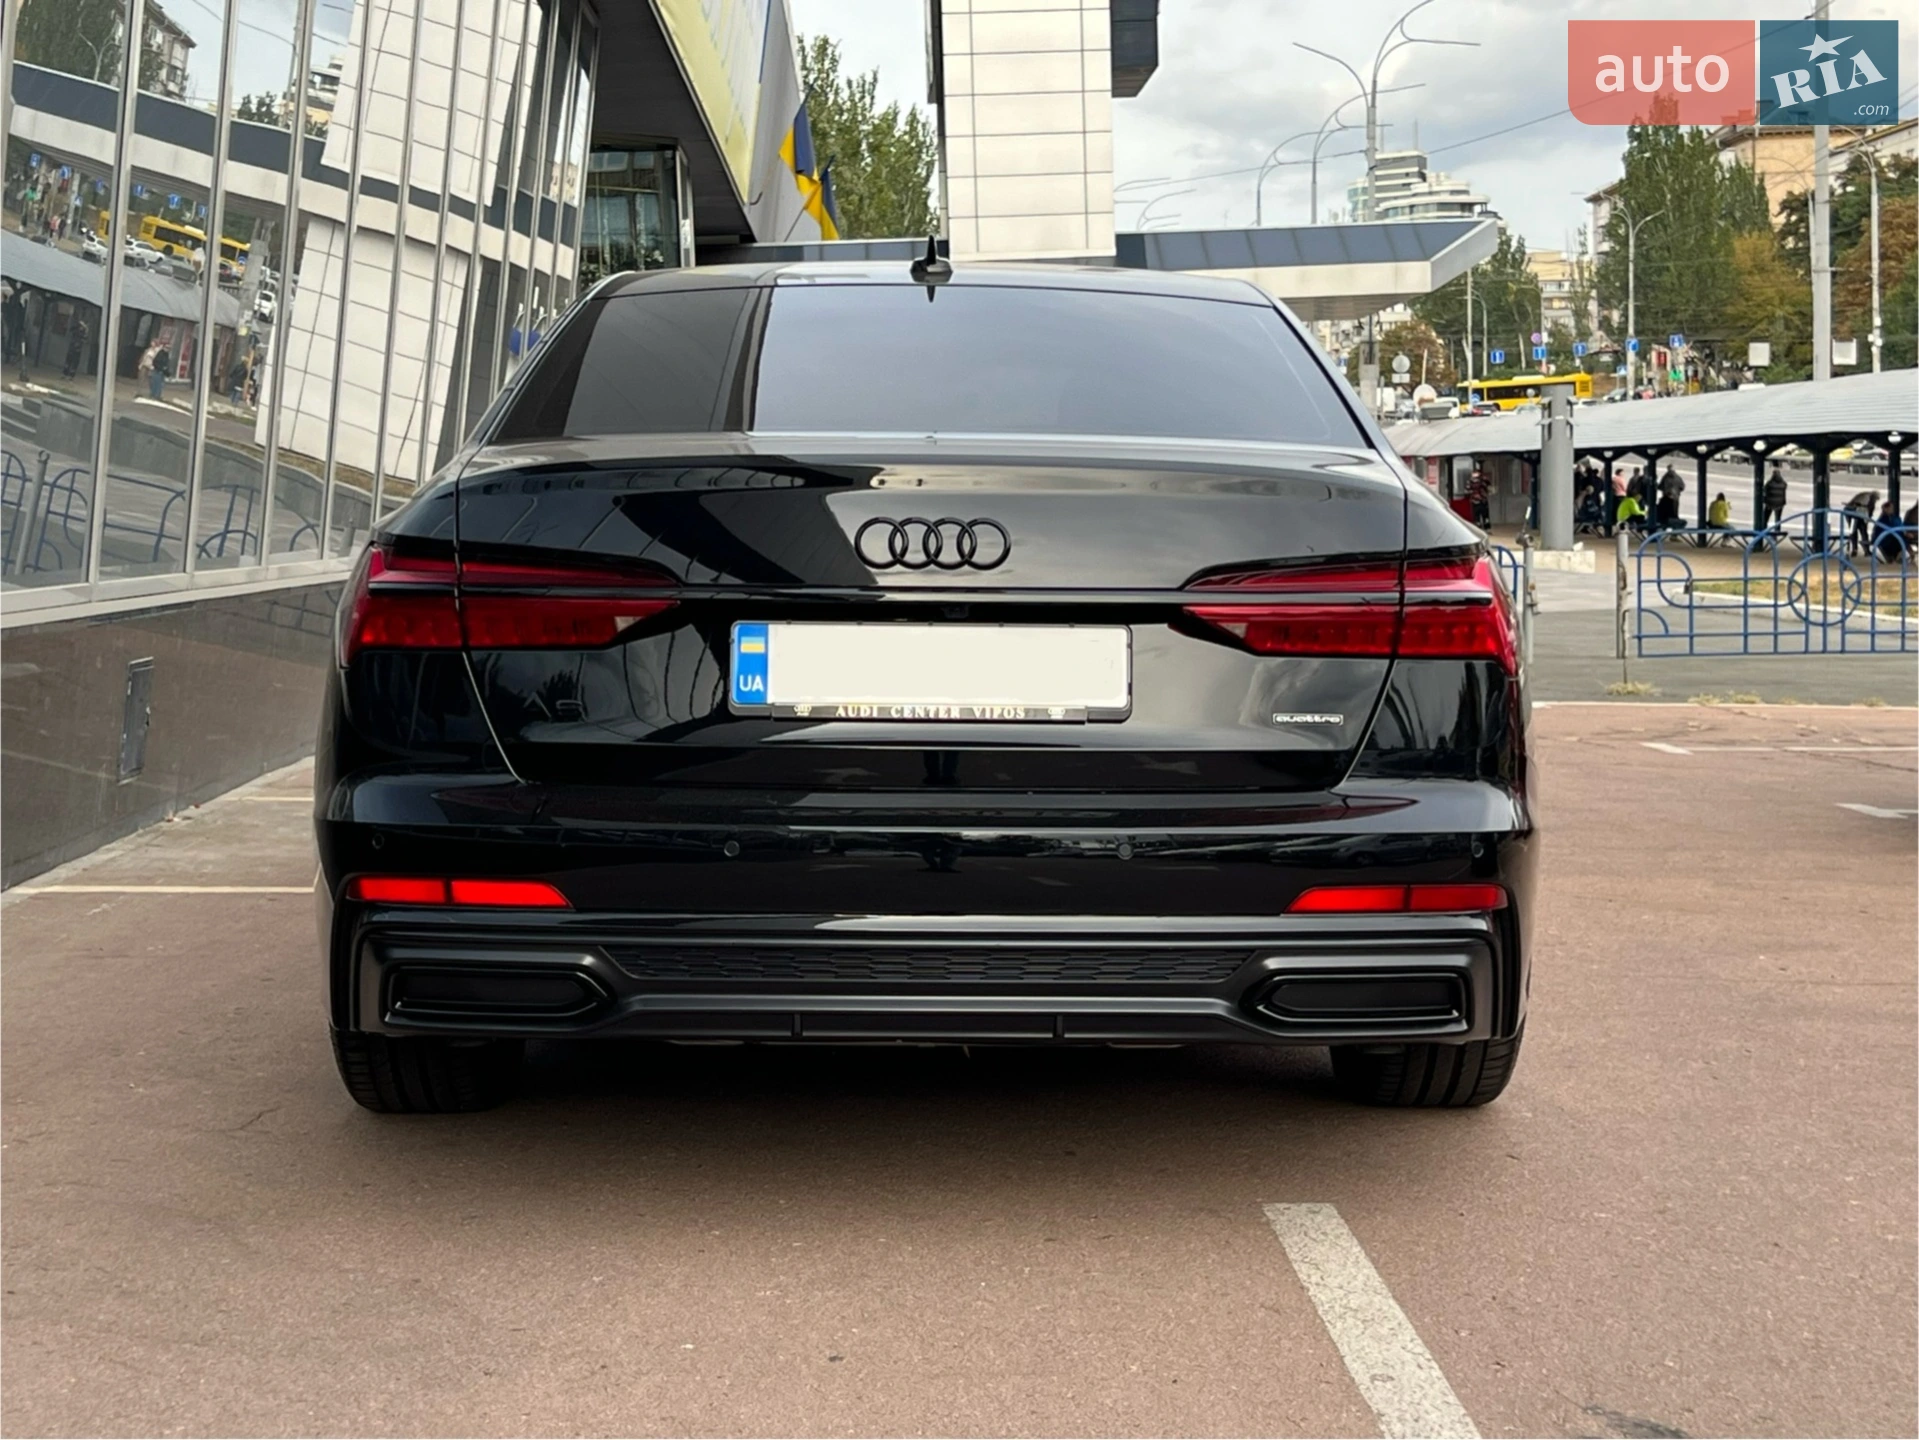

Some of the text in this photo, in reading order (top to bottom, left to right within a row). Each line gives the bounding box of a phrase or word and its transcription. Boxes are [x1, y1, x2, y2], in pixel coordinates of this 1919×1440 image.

[739, 674, 765, 692] UA
[836, 704, 878, 718] AUDI
[890, 705, 960, 719] CENTER
